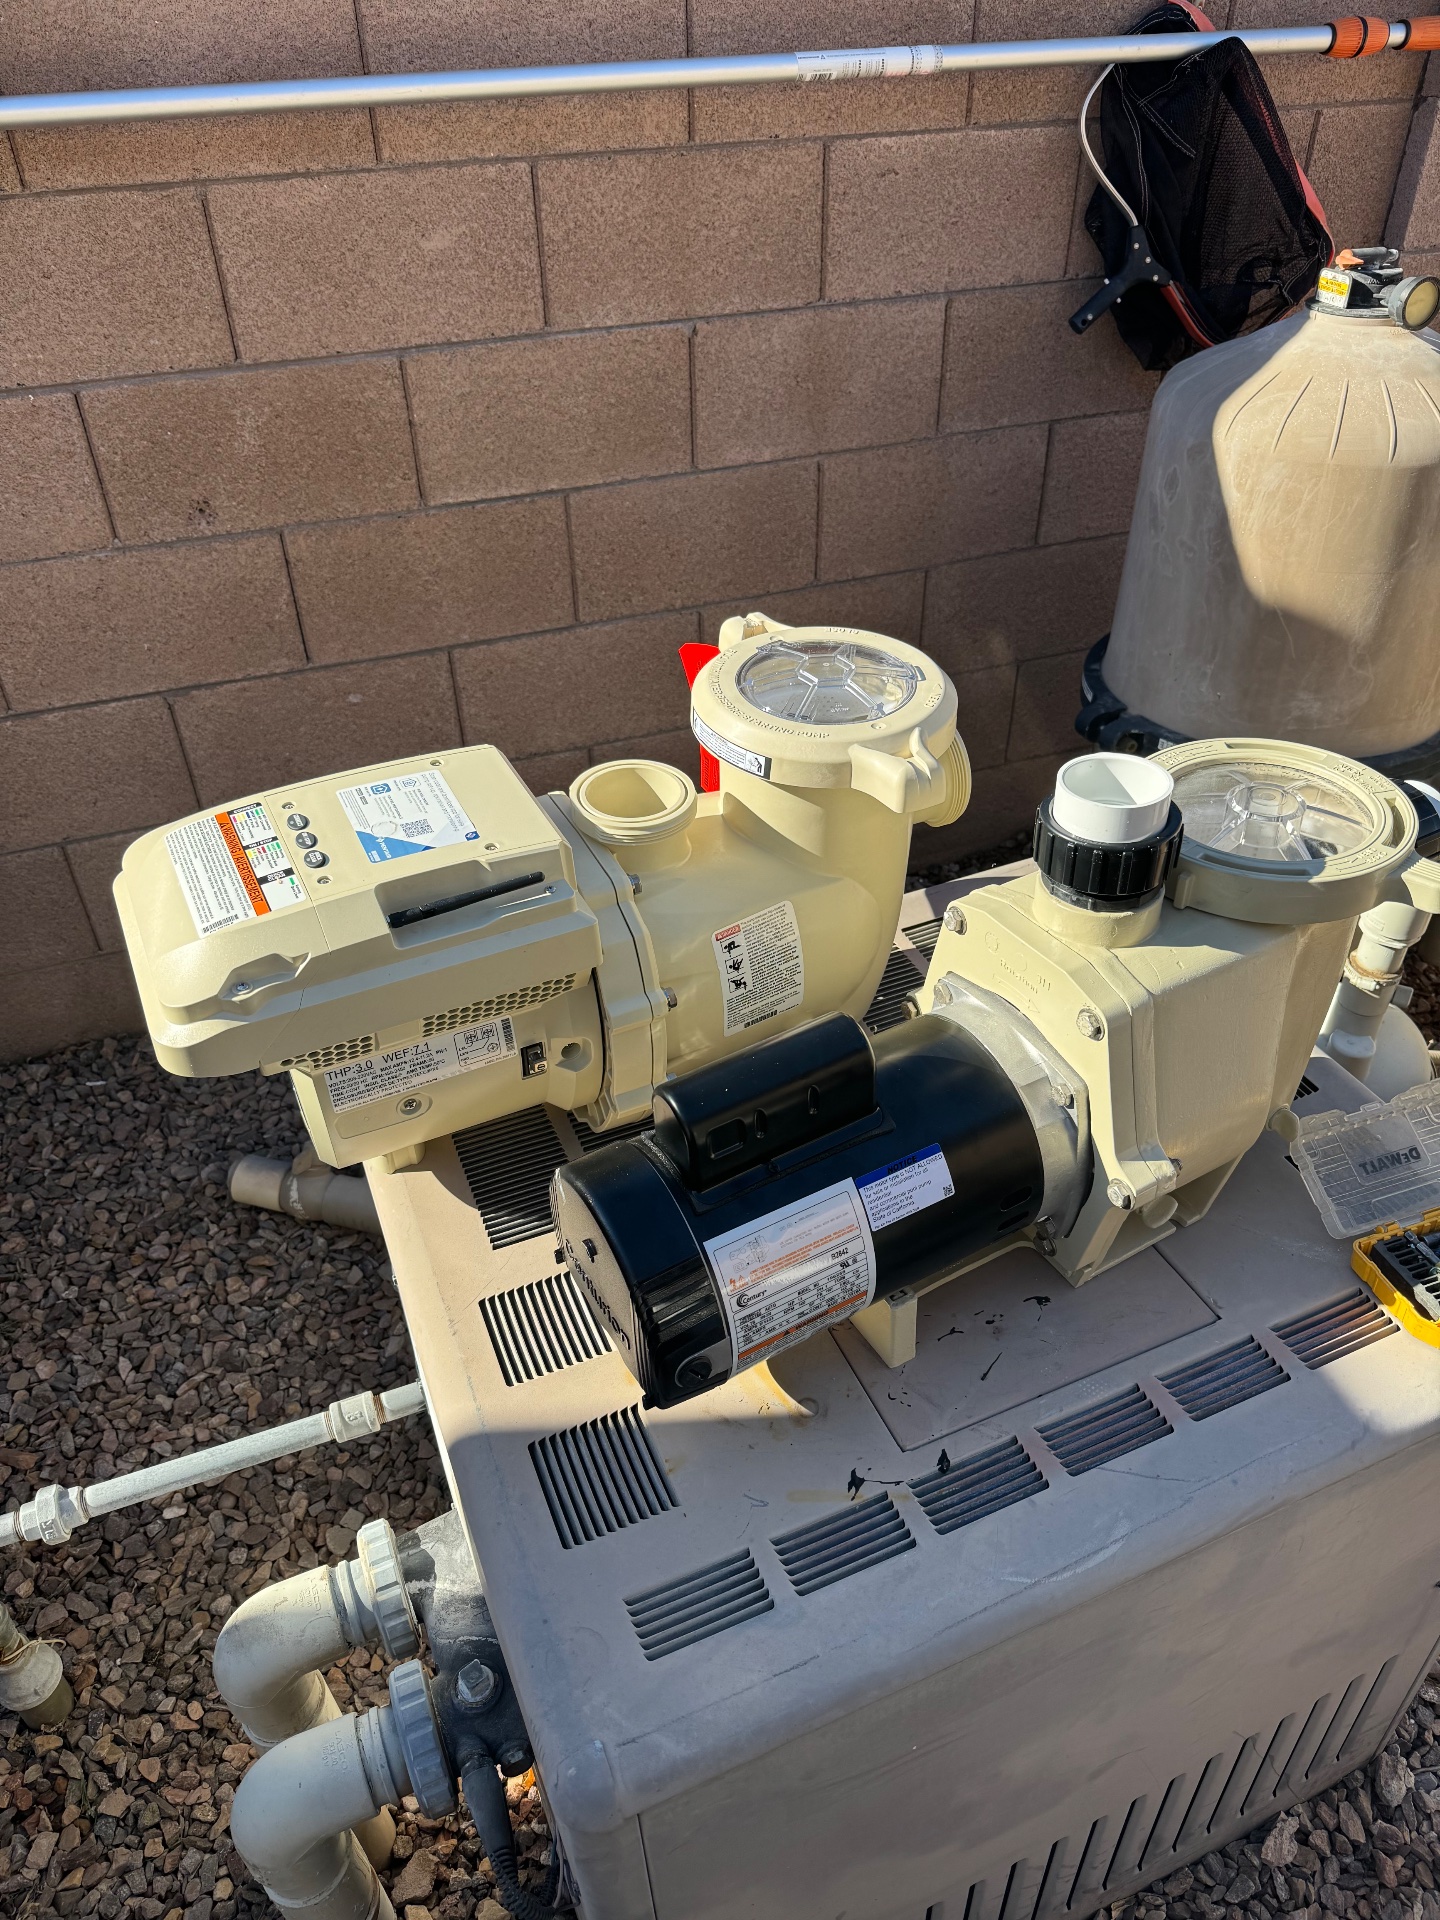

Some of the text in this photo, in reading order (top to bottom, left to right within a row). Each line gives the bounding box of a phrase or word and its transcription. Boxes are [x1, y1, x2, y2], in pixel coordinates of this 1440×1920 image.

[742, 714, 795, 735] STARTING
[797, 731, 830, 740] PUMP
[220, 825, 241, 853] WARNING
[233, 855, 262, 903] AVERTISSEMENT
[325, 1060, 373, 1081] THP:3.0
[383, 1042, 430, 1063] WEF:7.1
[887, 1155, 917, 1173] NOTICE
[905, 1165, 916, 1174] NOT
[917, 1154, 941, 1168] ALLOWED
[873, 1213, 885, 1222] State
[892, 1199, 914, 1213] California
[565, 1238, 631, 1351] Centurion
[742, 1287, 764, 1304] Century
[795, 1309, 828, 1330] WARNING
[334, 1730, 349, 1770] LASCO
